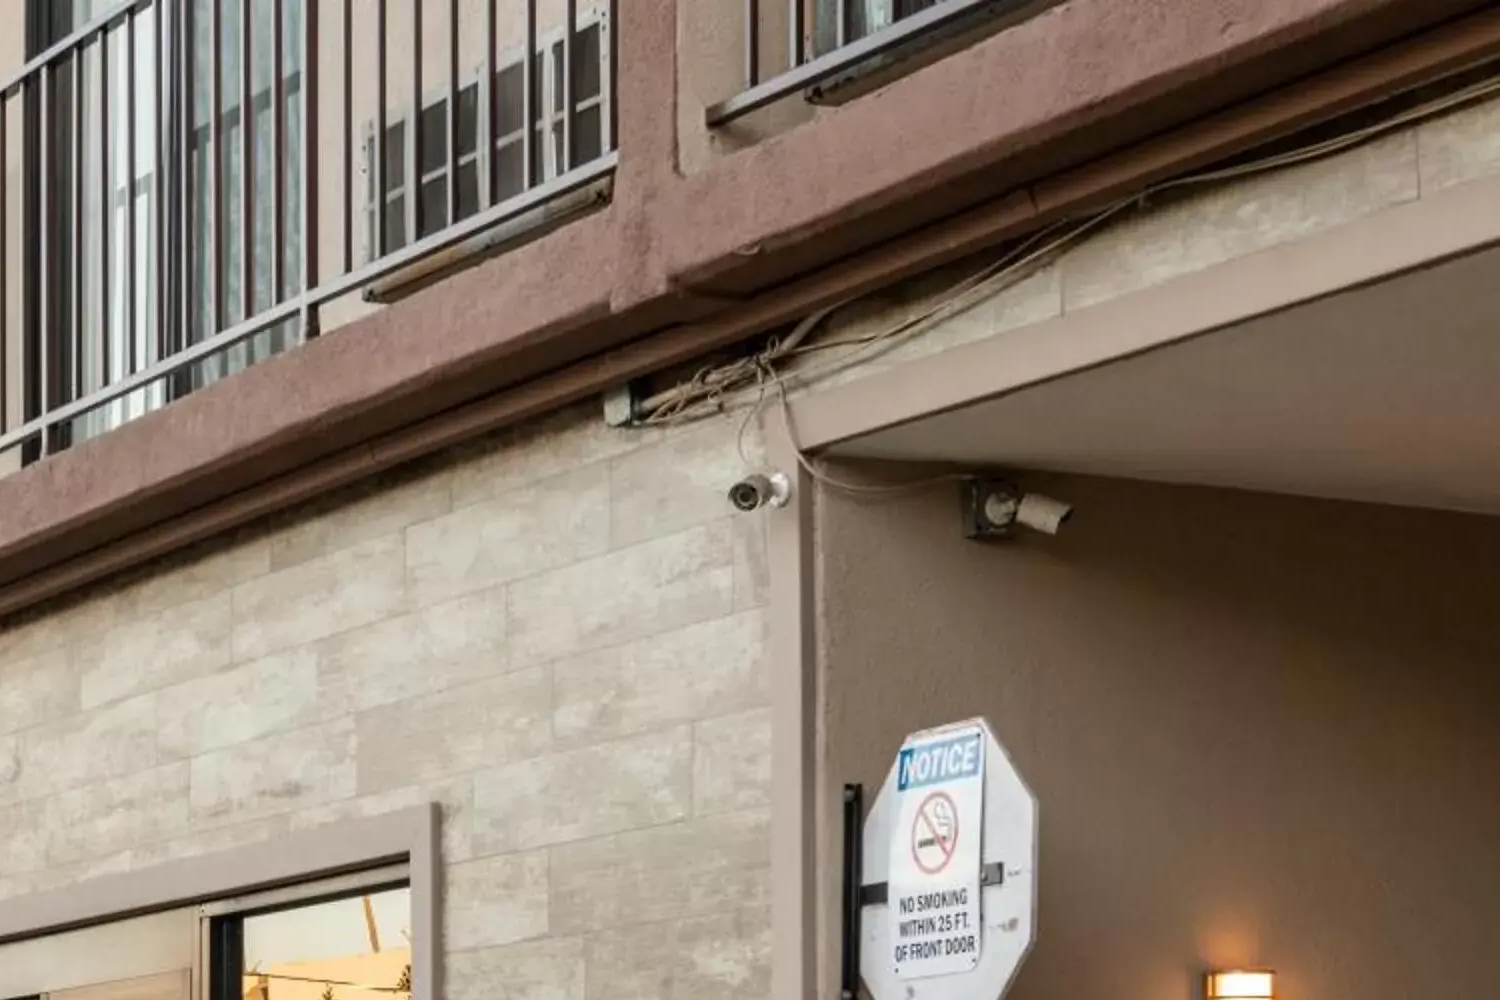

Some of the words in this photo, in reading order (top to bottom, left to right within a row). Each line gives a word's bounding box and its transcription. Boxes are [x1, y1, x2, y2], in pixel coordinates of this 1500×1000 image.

[901, 741, 978, 782] NOTICE
[899, 895, 915, 914] NO
[917, 888, 968, 911] SMOKING
[899, 917, 936, 938] WITHIN
[938, 915, 952, 934] 25
[954, 911, 971, 930] FT.
[895, 945, 908, 963] OF
[909, 940, 943, 960] FRONT
[945, 935, 976, 957] DOOR
